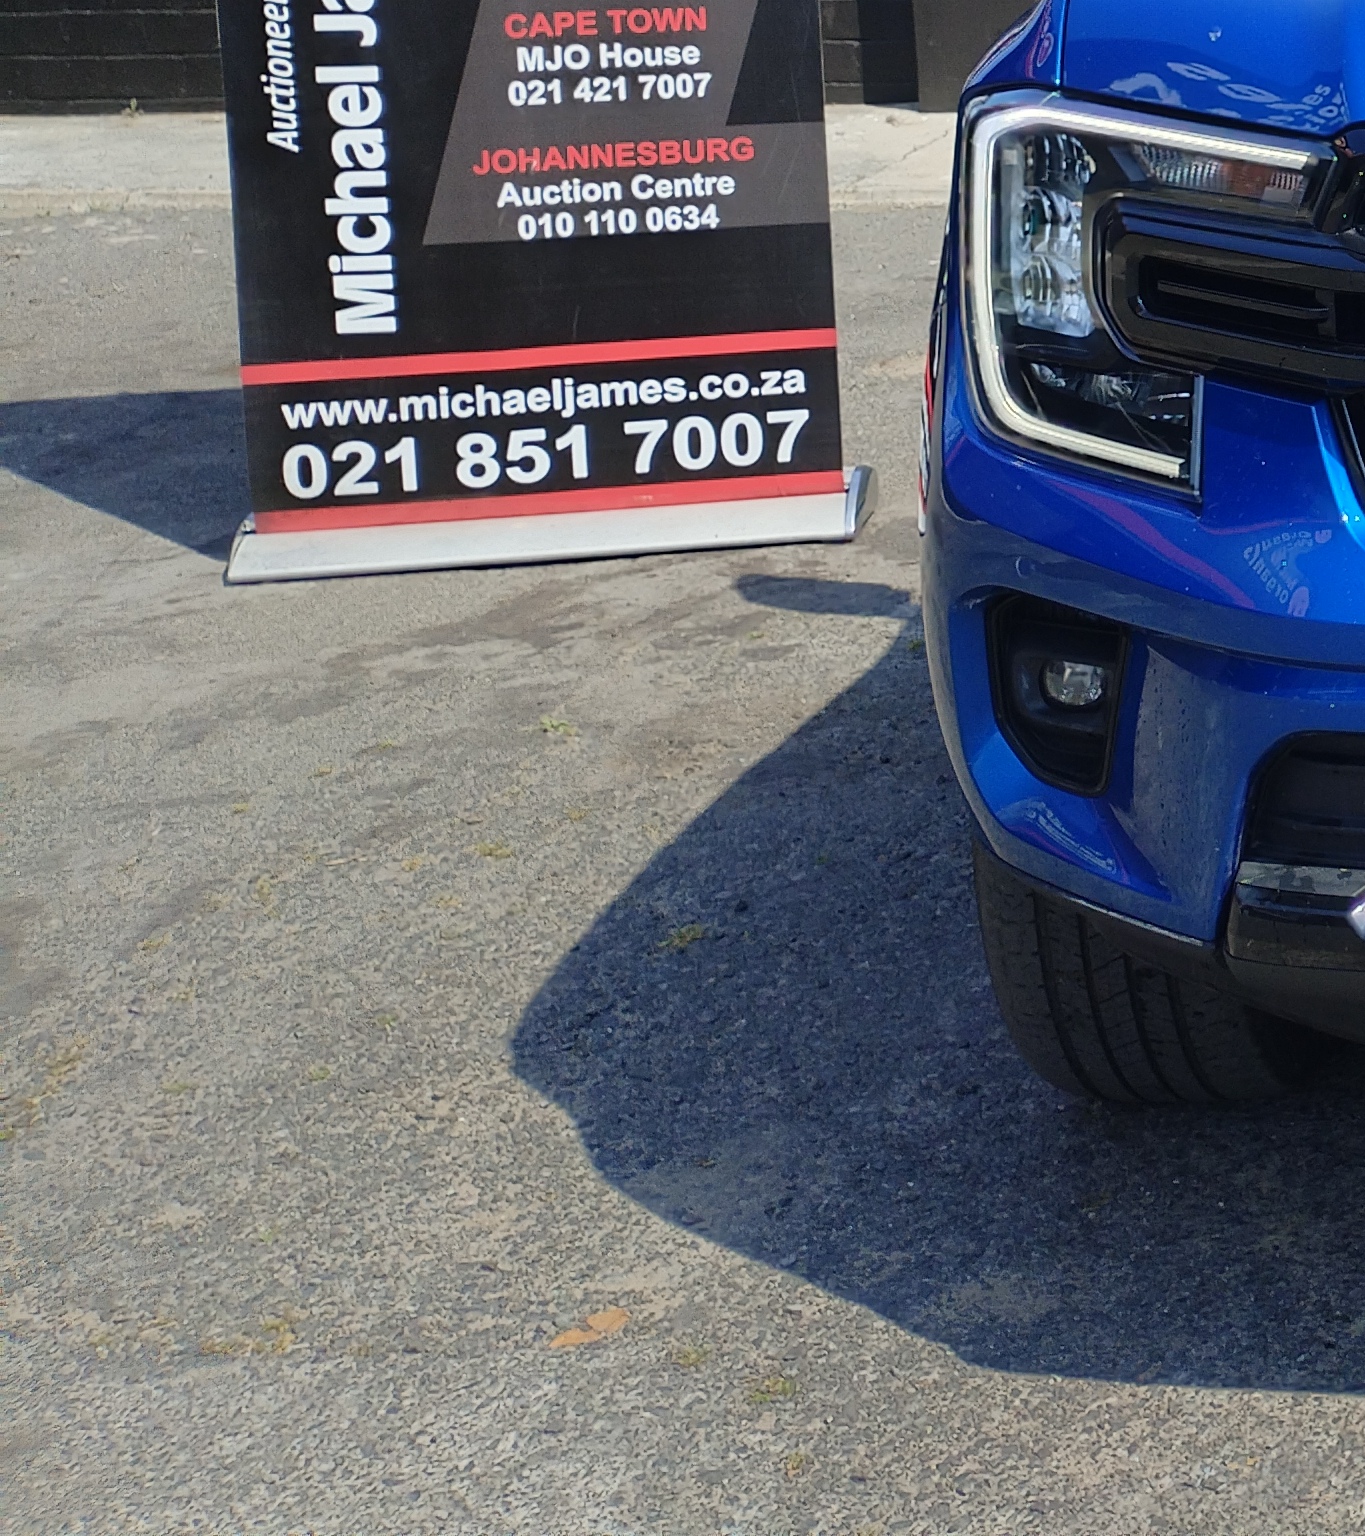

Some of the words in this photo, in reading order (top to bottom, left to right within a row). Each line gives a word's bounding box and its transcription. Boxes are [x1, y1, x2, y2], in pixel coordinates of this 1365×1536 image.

[504, 10, 598, 39] CAPE
[607, 7, 707, 34] TOWN
[516, 43, 591, 73] MJO
[598, 42, 701, 69] House
[507, 78, 562, 107] 021
[573, 75, 627, 103] 421
[637, 72, 713, 100] 7007
[473, 136, 755, 175] JOHANNESBURG
[315, 65, 397, 334] Michael
[496, 177, 623, 208] Auction
[630, 172, 736, 200] Centre
[517, 211, 575, 241] 010
[583, 208, 637, 236] 110
[645, 203, 721, 233] 0634
[280, 368, 806, 430] www.michaeljames.co.za
[280, 438, 418, 500] 021
[456, 424, 589, 488] 851
[623, 408, 810, 474] 7007
